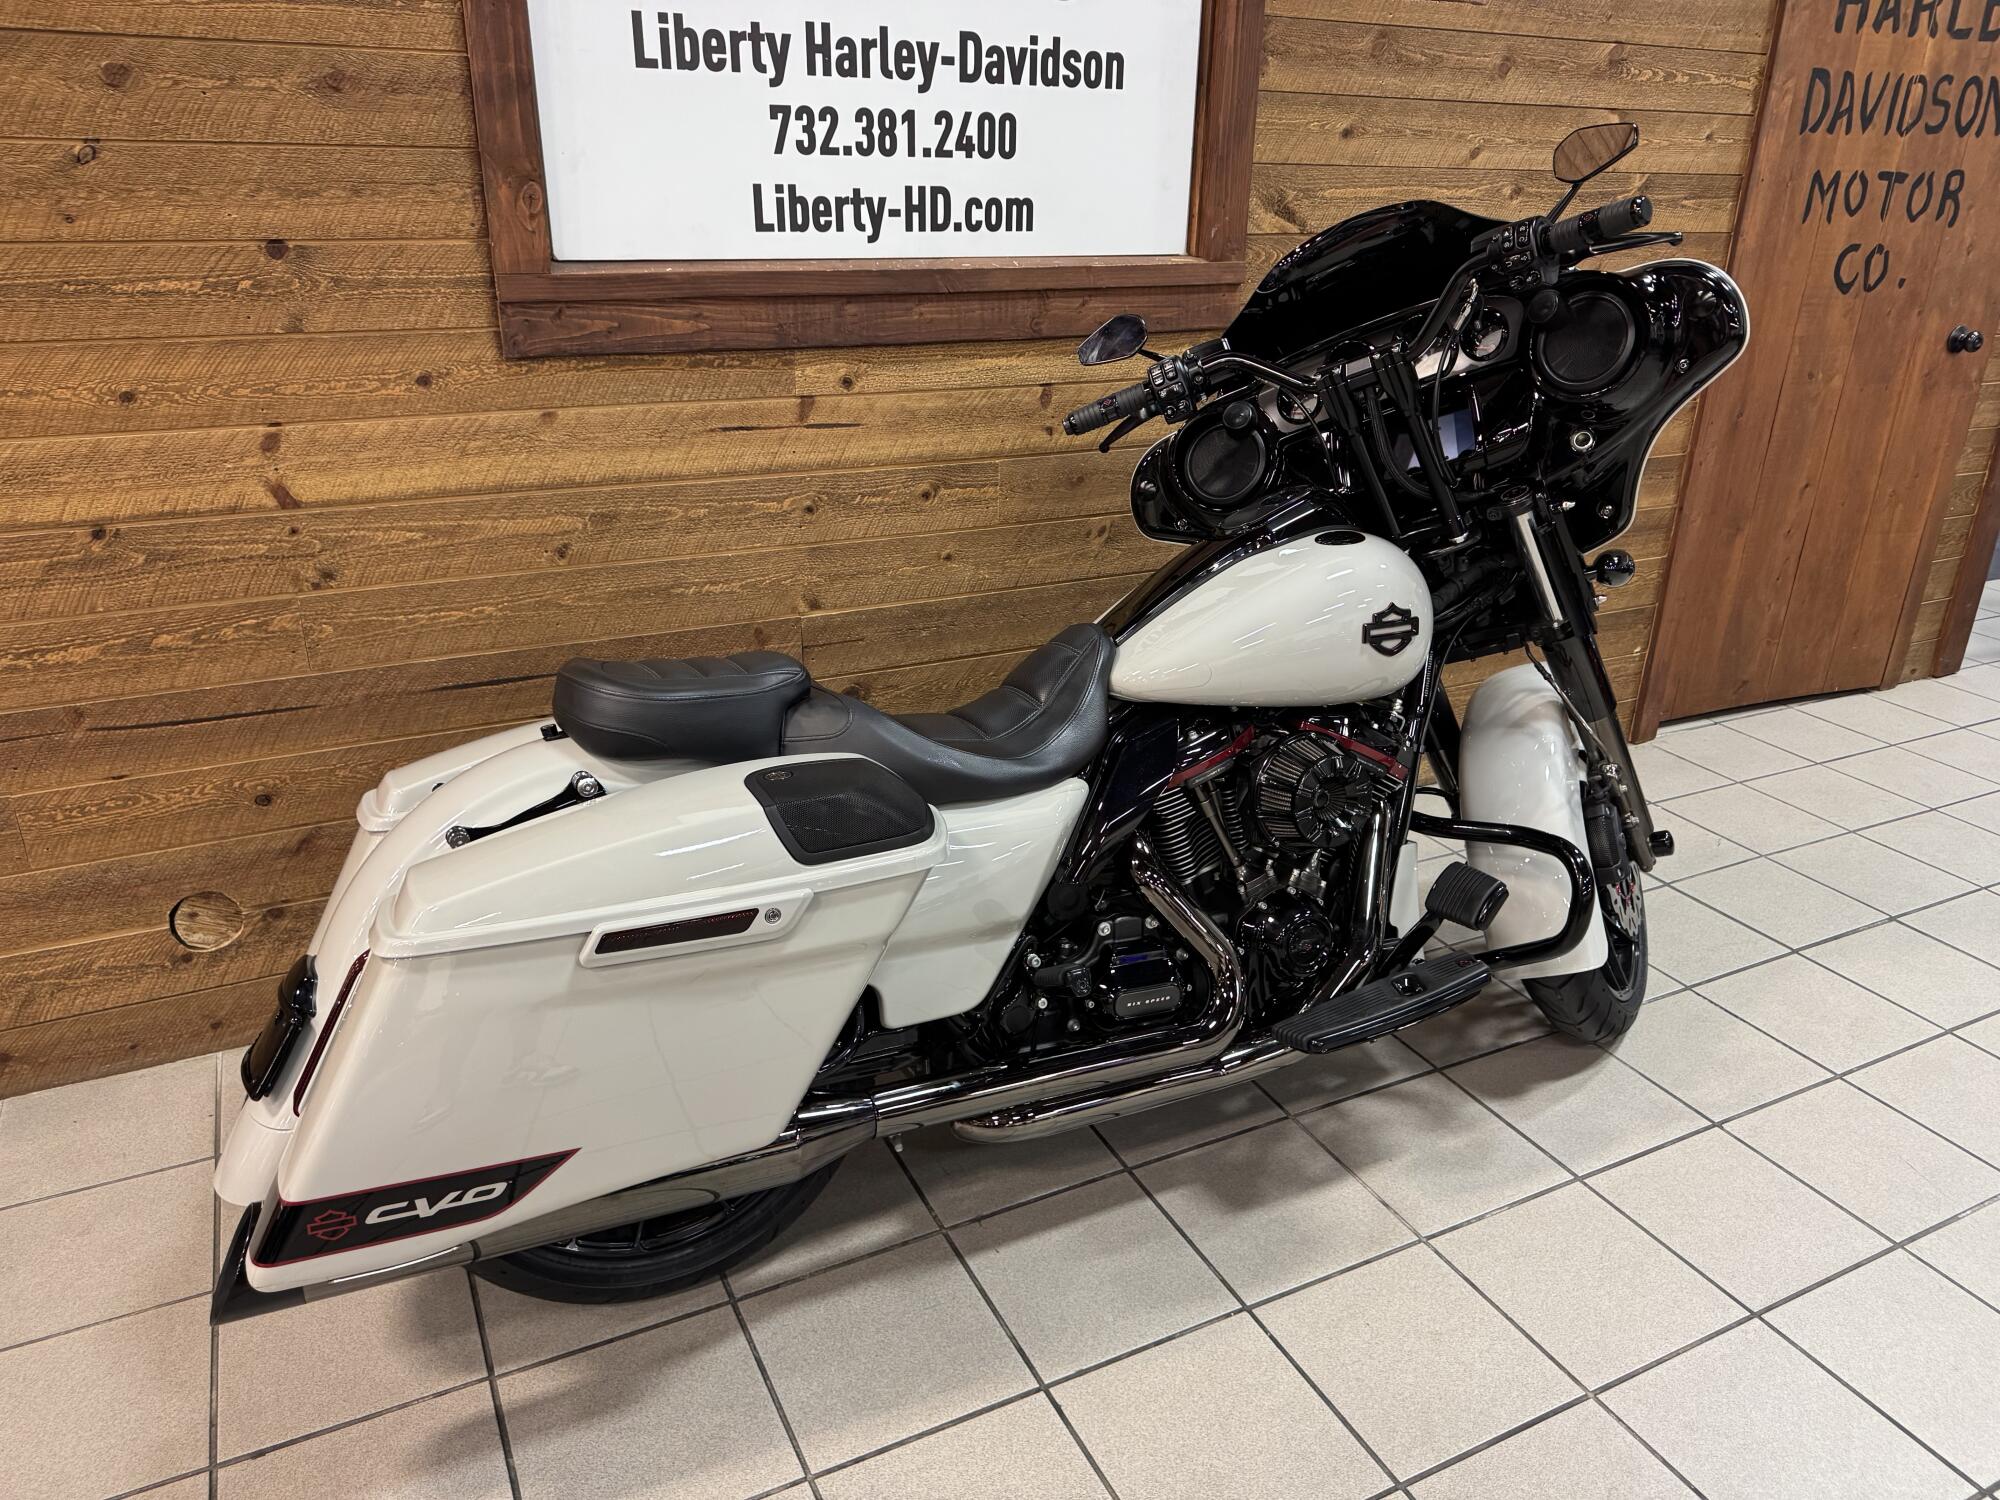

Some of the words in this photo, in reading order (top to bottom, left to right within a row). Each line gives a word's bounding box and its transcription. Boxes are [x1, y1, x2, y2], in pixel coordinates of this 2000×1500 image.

[630, 10, 792, 88] Liberty
[804, 20, 1126, 94] Harley-Davidson
[769, 104, 1017, 160] 732.381.2400
[752, 183, 1034, 244] Liberty-HD.com
[1801, 169, 1966, 229] MOTOR
[1833, 243, 1907, 296] CO.
[365, 1182, 509, 1225] CVO
